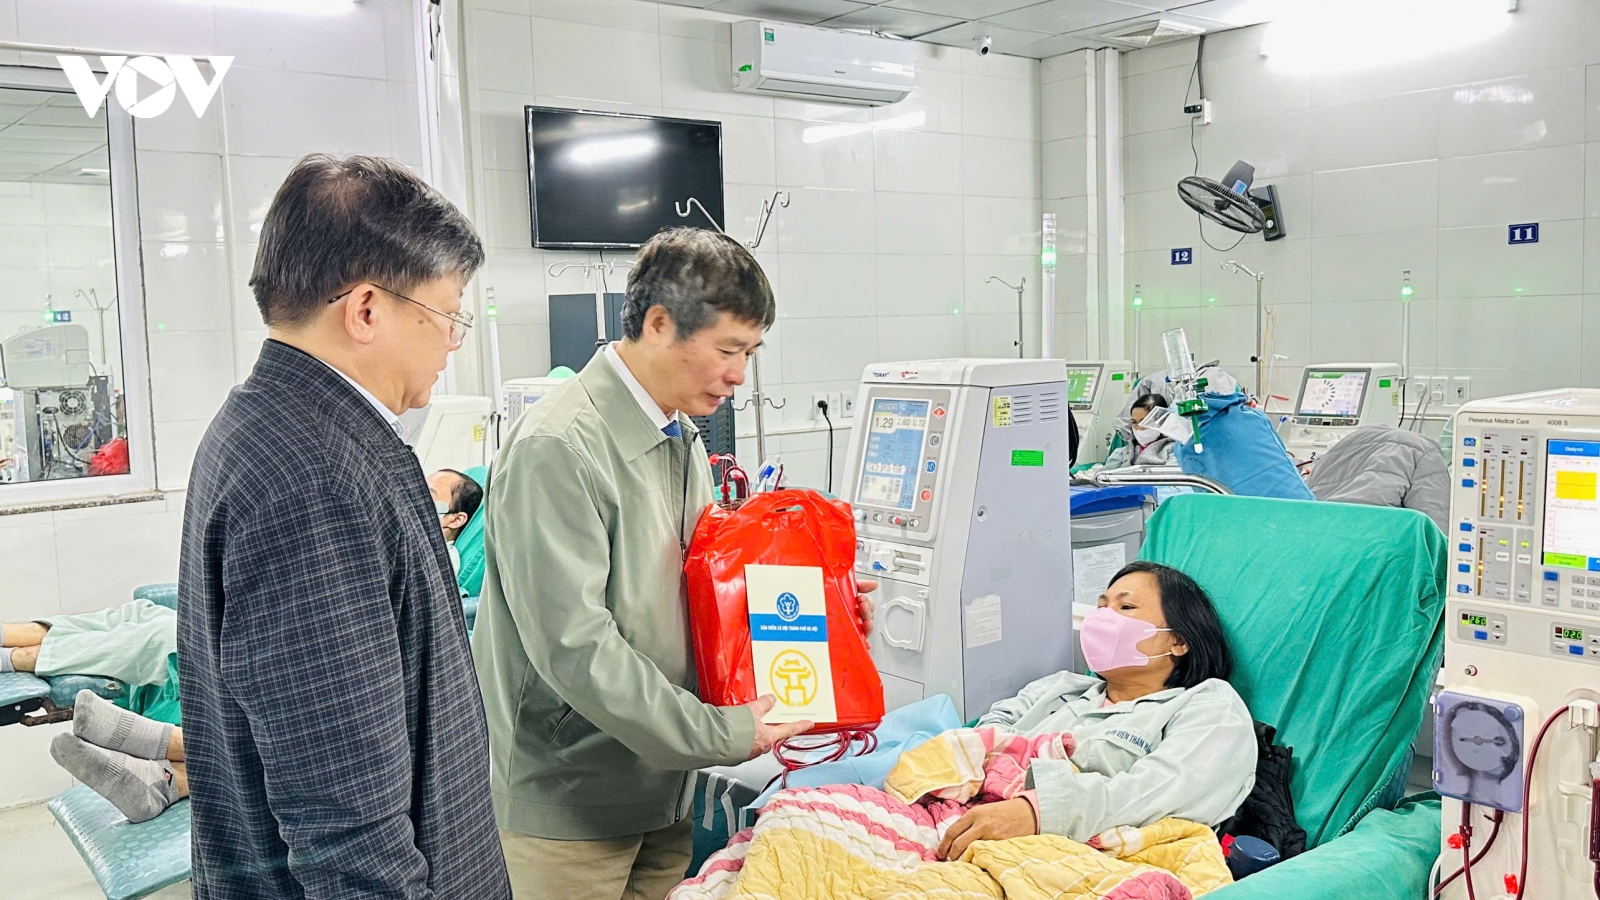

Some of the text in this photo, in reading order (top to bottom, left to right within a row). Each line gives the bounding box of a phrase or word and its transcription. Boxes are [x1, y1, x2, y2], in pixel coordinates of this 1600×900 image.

[1512, 227, 1535, 241] 11
[1175, 251, 1189, 262] 12
[875, 417, 894, 429] 1.29
[897, 418, 911, 426] 2.60
[1468, 416, 1493, 424] Fresenius
[1494, 417, 1515, 425] Medical
[1469, 616, 1487, 626] 260
